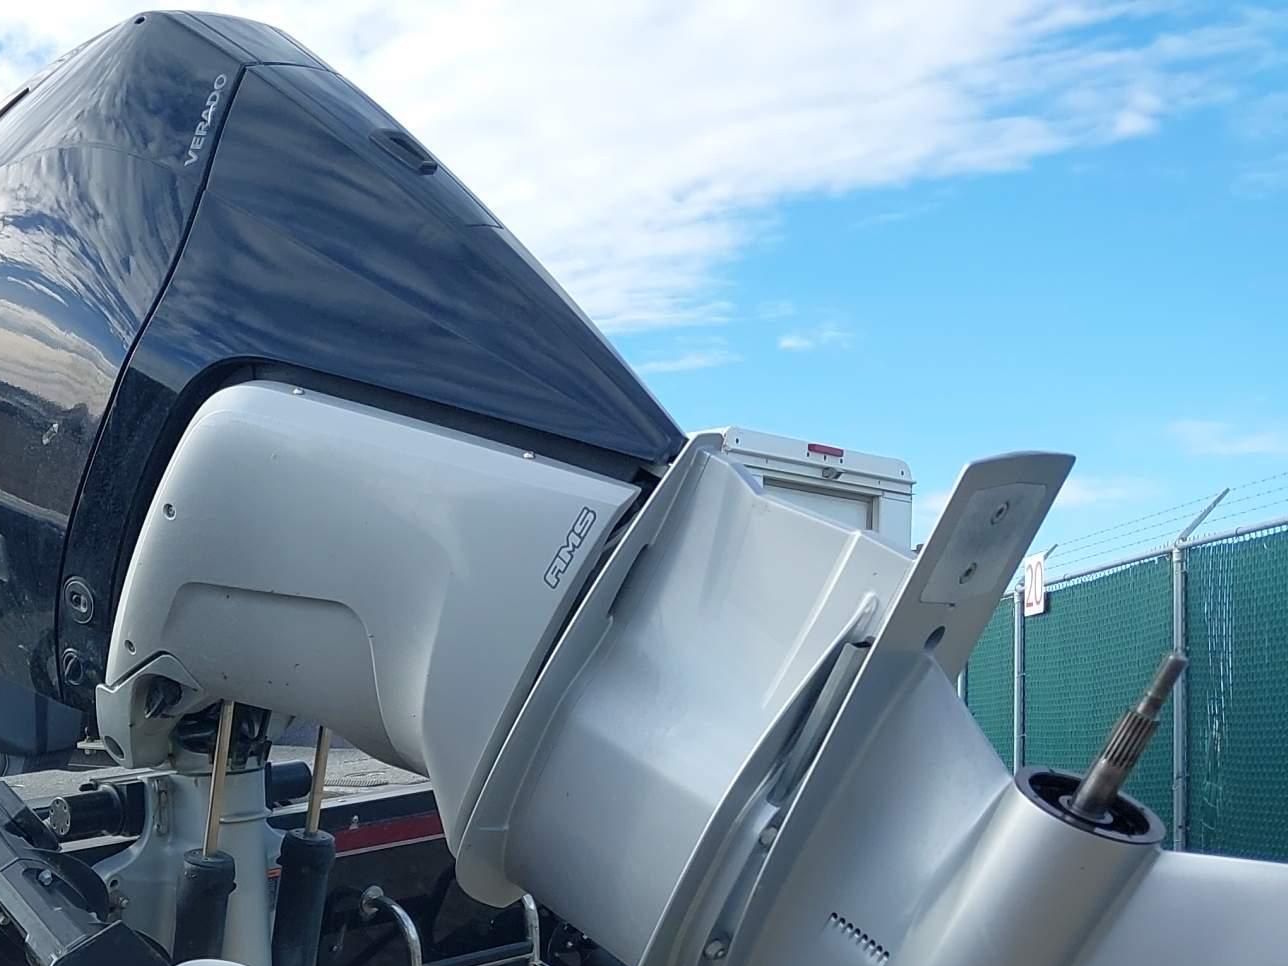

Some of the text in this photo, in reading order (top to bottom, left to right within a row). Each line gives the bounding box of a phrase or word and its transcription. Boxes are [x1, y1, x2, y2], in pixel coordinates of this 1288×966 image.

[184, 73, 227, 166] VERADO
[543, 506, 597, 589] AMS
[1025, 560, 1043, 608] 20
